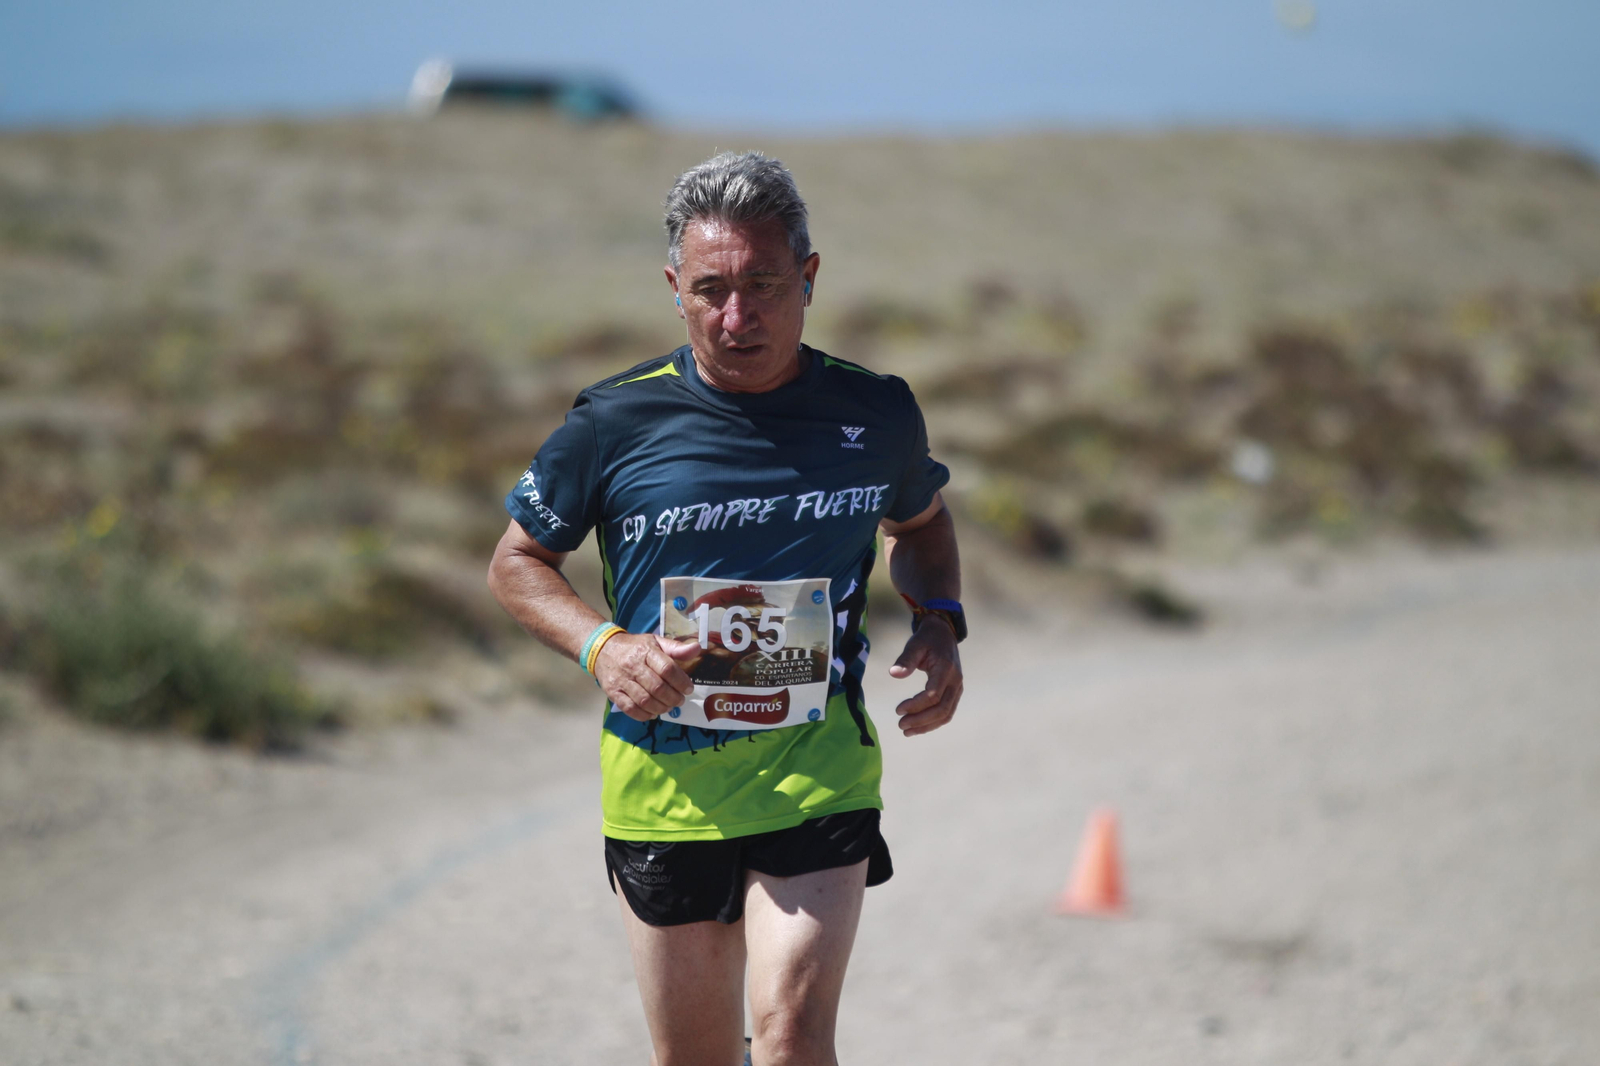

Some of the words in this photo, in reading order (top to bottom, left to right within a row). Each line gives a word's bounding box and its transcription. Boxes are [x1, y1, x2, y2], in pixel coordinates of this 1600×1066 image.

[841, 442, 865, 450] HORME
[523, 489, 570, 530] FUERTE
[622, 515, 646, 542] CD
[655, 494, 789, 536] SIEMPRE
[794, 484, 889, 521] FUERTE
[688, 603, 788, 653] 165
[757, 648, 814, 662] XIII
[755, 666, 812, 675] POPULAR
[768, 671, 813, 680] ESPARTANOS
[774, 676, 812, 686] ALQUIÁN
